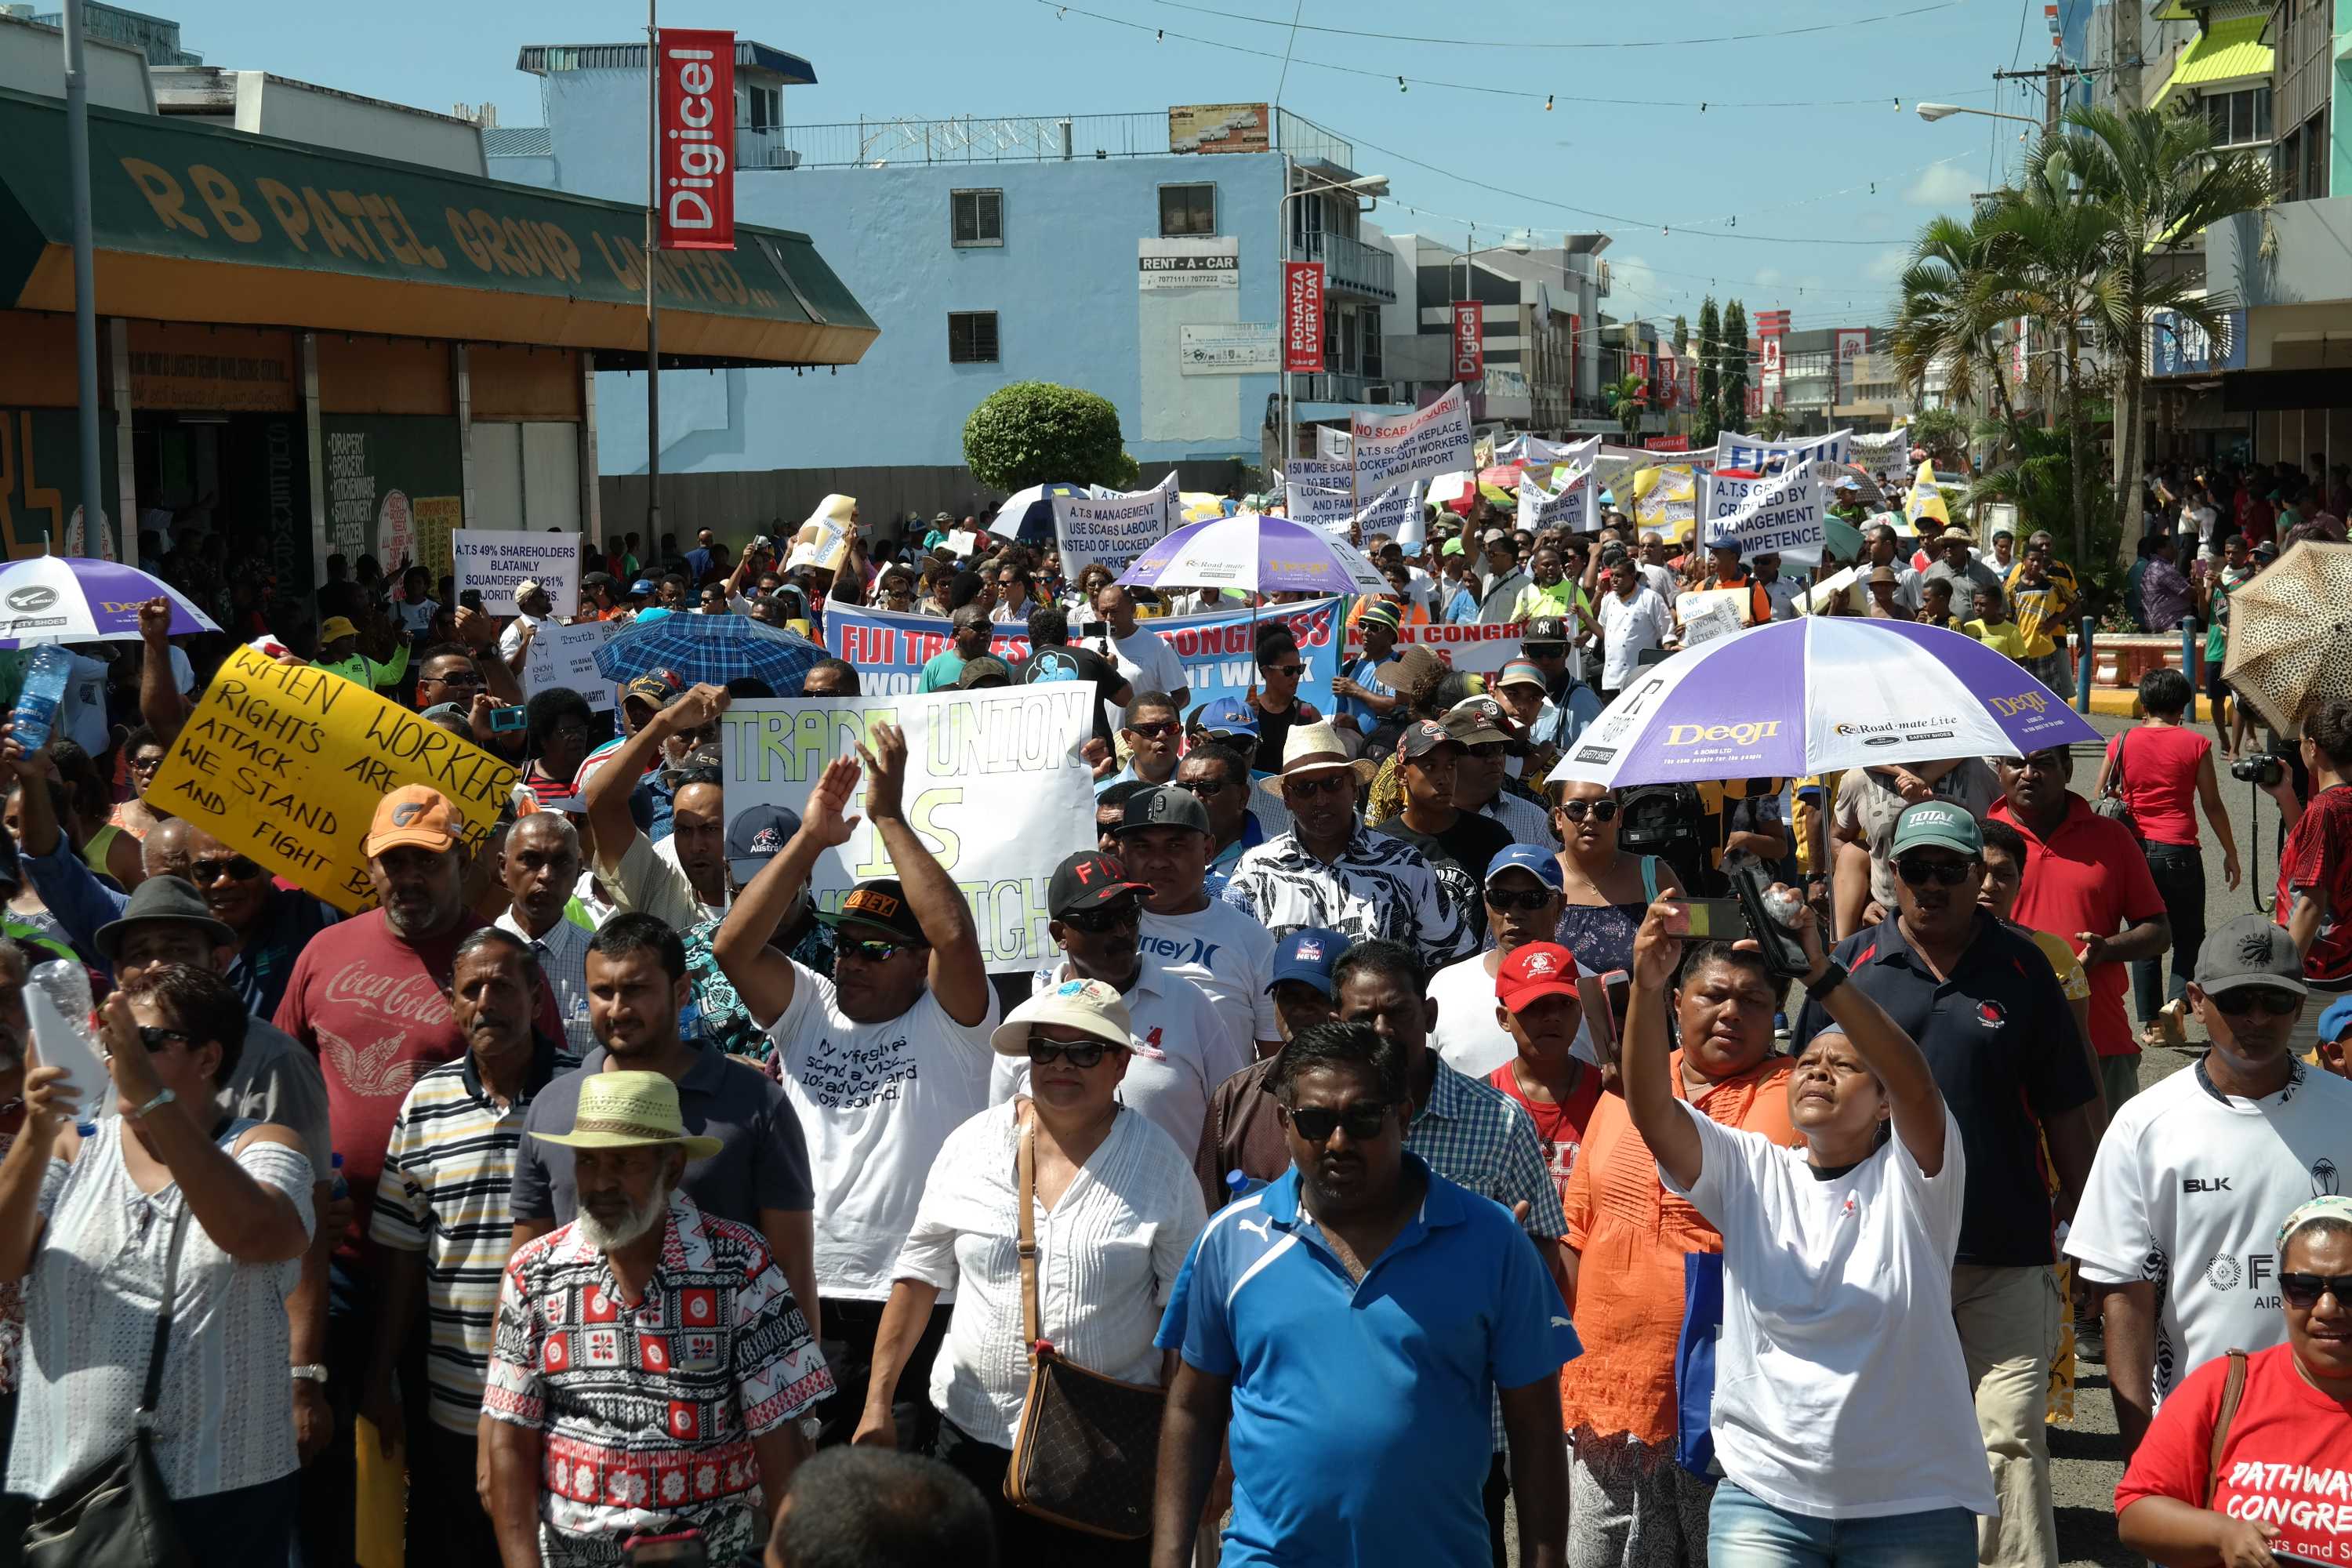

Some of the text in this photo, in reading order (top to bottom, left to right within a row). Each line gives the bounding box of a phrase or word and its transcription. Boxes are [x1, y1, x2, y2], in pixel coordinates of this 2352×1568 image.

[669, 49, 725, 229] Digicel
[257, 176, 446, 269] PATEL
[445, 206, 581, 283] GROUP
[1143, 258, 1177, 270] RENT
[1186, 258, 1196, 269] A
[1206, 257, 1234, 269] CAR
[1292, 270, 1305, 350] BONANZA
[1305, 268, 1317, 353] EVERY DAY
[1457, 307, 1475, 374] Digicel
[1660, 361, 1671, 399] Digicel
[1355, 423, 1407, 437] NO SCAB
[1356, 420, 1463, 457] A.T.S SCABS REPLACE
[331, 432, 365, 456] DRAPERY
[1418, 434, 1469, 455] WORKERS
[332, 455, 365, 477] GROCERY
[1288, 462, 1327, 475] 150 MORE
[1373, 451, 1454, 482] AT NADI AIRPORT
[1866, 456, 1892, 465] TRADE
[333, 475, 376, 500] KITCHENWARE
[1306, 477, 1332, 488] TO BE
[1715, 481, 1748, 498] A.T.S
[1540, 500, 1559, 514] HAVE
[1560, 494, 1580, 507] BEEN
[1788, 485, 1807, 503] BY
[334, 499, 372, 523] STATIONERY
[1069, 503, 1155, 521] A.T.S MANAGEMENT
[1312, 500, 1331, 510] AND
[1379, 496, 1419, 513] PROTEST
[1069, 519, 1159, 535] USE SCABS LABOUR
[1362, 511, 1421, 531] GOVERNMENT
[1713, 506, 1814, 536] MANAGEMENT
[336, 522, 365, 545] FROZEN
[456, 545, 575, 557] A.T.S 49% SHAREHOLDERS
[1061, 539, 1110, 553] INSTEAD OF
[491, 560, 539, 572] BLATAINLY
[546, 576, 564, 587] 51%
[1686, 595, 1700, 607] WE
[1724, 596, 1738, 616] SIGN
[34, 617, 67, 627] SHOES
[561, 631, 596, 645] Truth
[840, 623, 895, 666] FIJI
[234, 651, 347, 716] WHEN
[628, 675, 666, 693] Sydney
[1931, 716, 1958, 727] Lite
[721, 691, 1087, 782] TRADE UNION
[344, 755, 399, 795] ARE
[179, 738, 338, 837] WE STAND
[173, 779, 334, 873] AND FIGHT
[1908, 809, 1955, 824] TOTAL
[855, 787, 964, 877] IS
[884, 1064, 917, 1084] and
[2183, 1177, 2233, 1193] BLK
[2297, 1540, 2333, 1559] and
